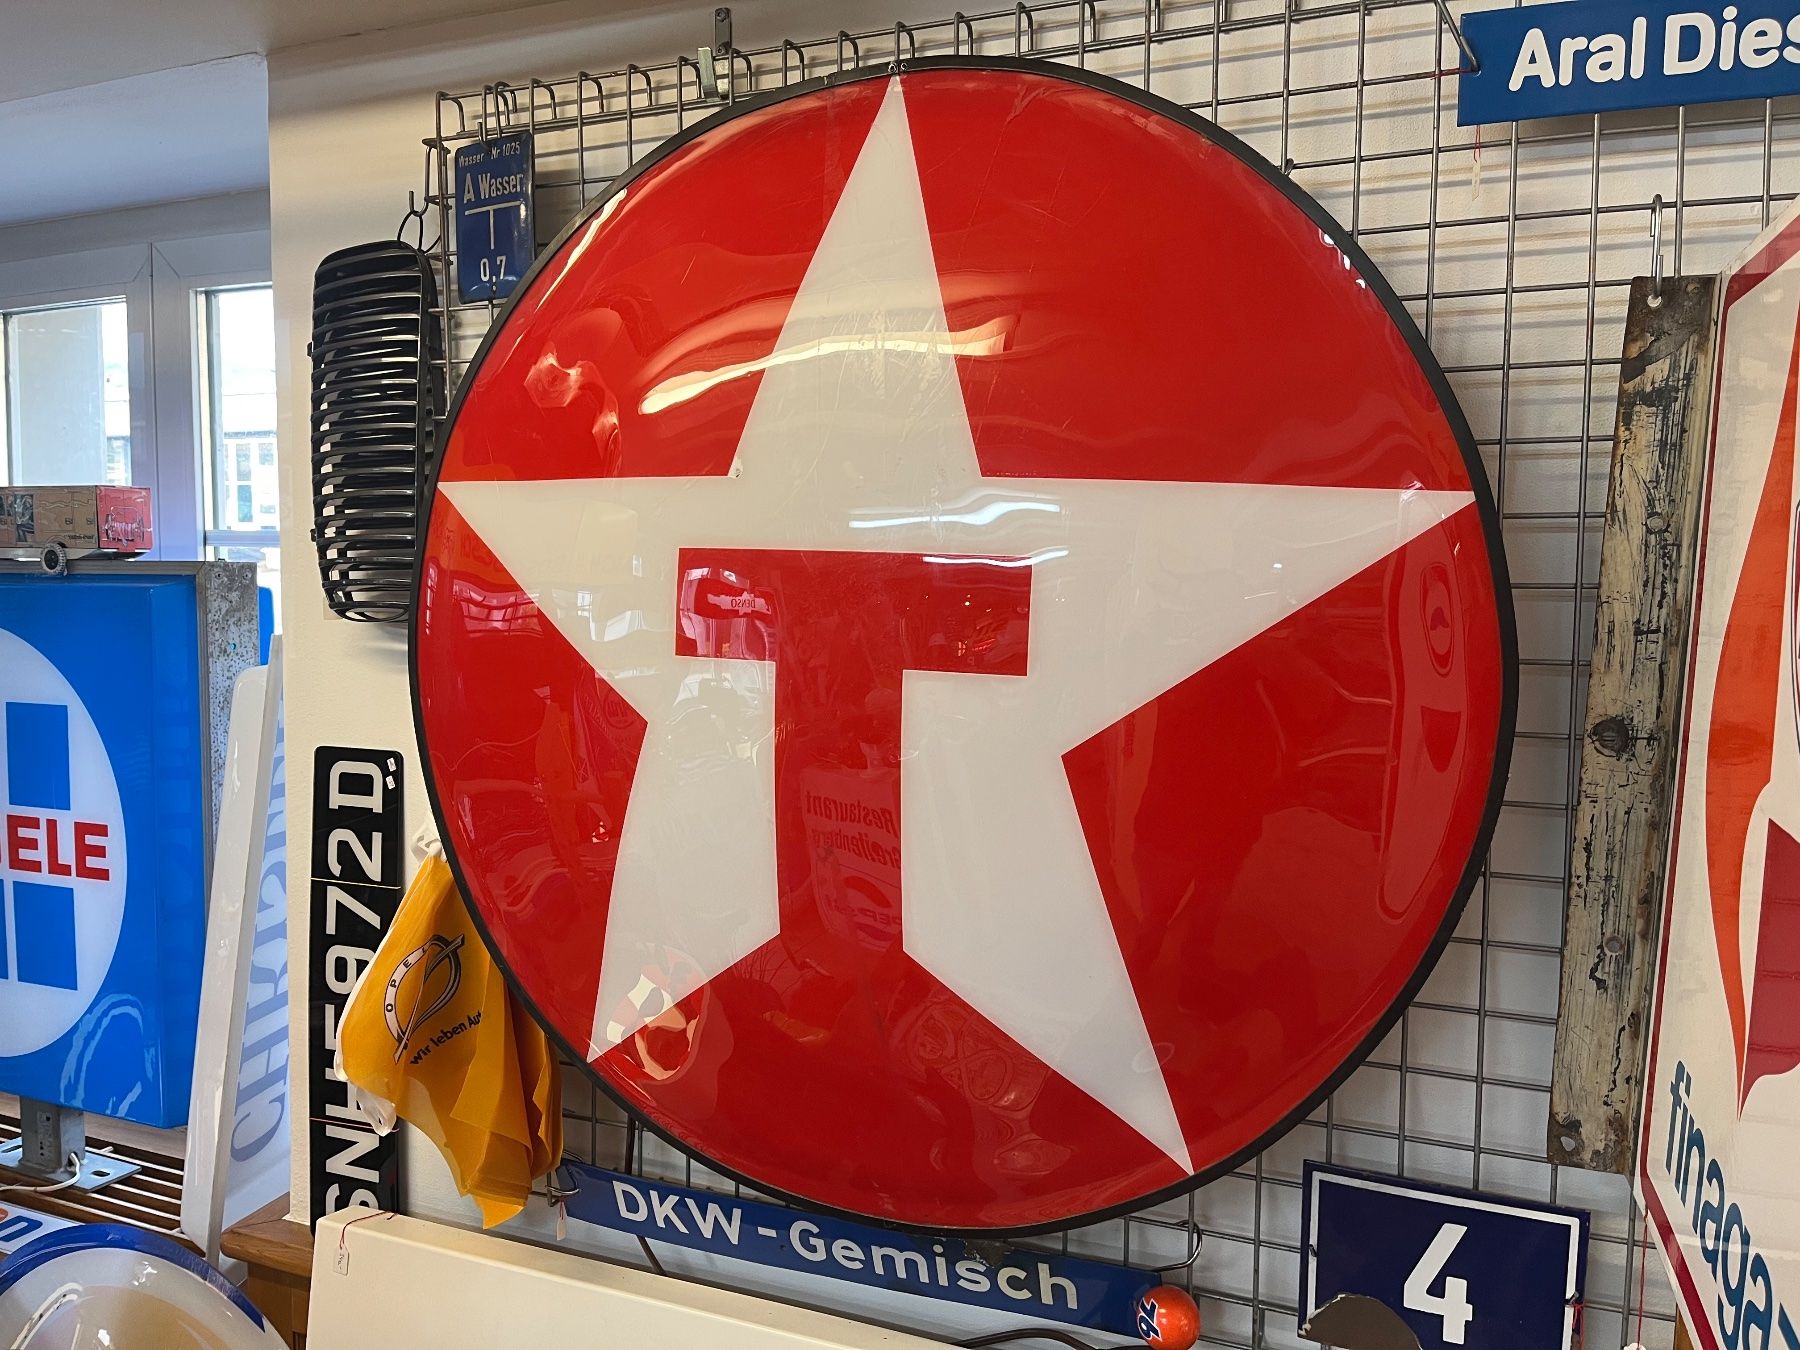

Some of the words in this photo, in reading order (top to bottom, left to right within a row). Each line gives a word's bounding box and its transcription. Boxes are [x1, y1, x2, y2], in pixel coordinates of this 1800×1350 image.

[1508, 16, 1647, 92] Aral
[458, 152, 485, 168] Wasser
[502, 141, 521, 157] 1025
[463, 172, 475, 204] A
[478, 172, 524, 200] Wasser
[0, 812, 110, 881] ELE
[430, 1022, 467, 1047] leben
[1404, 1222, 1473, 1345] 4
